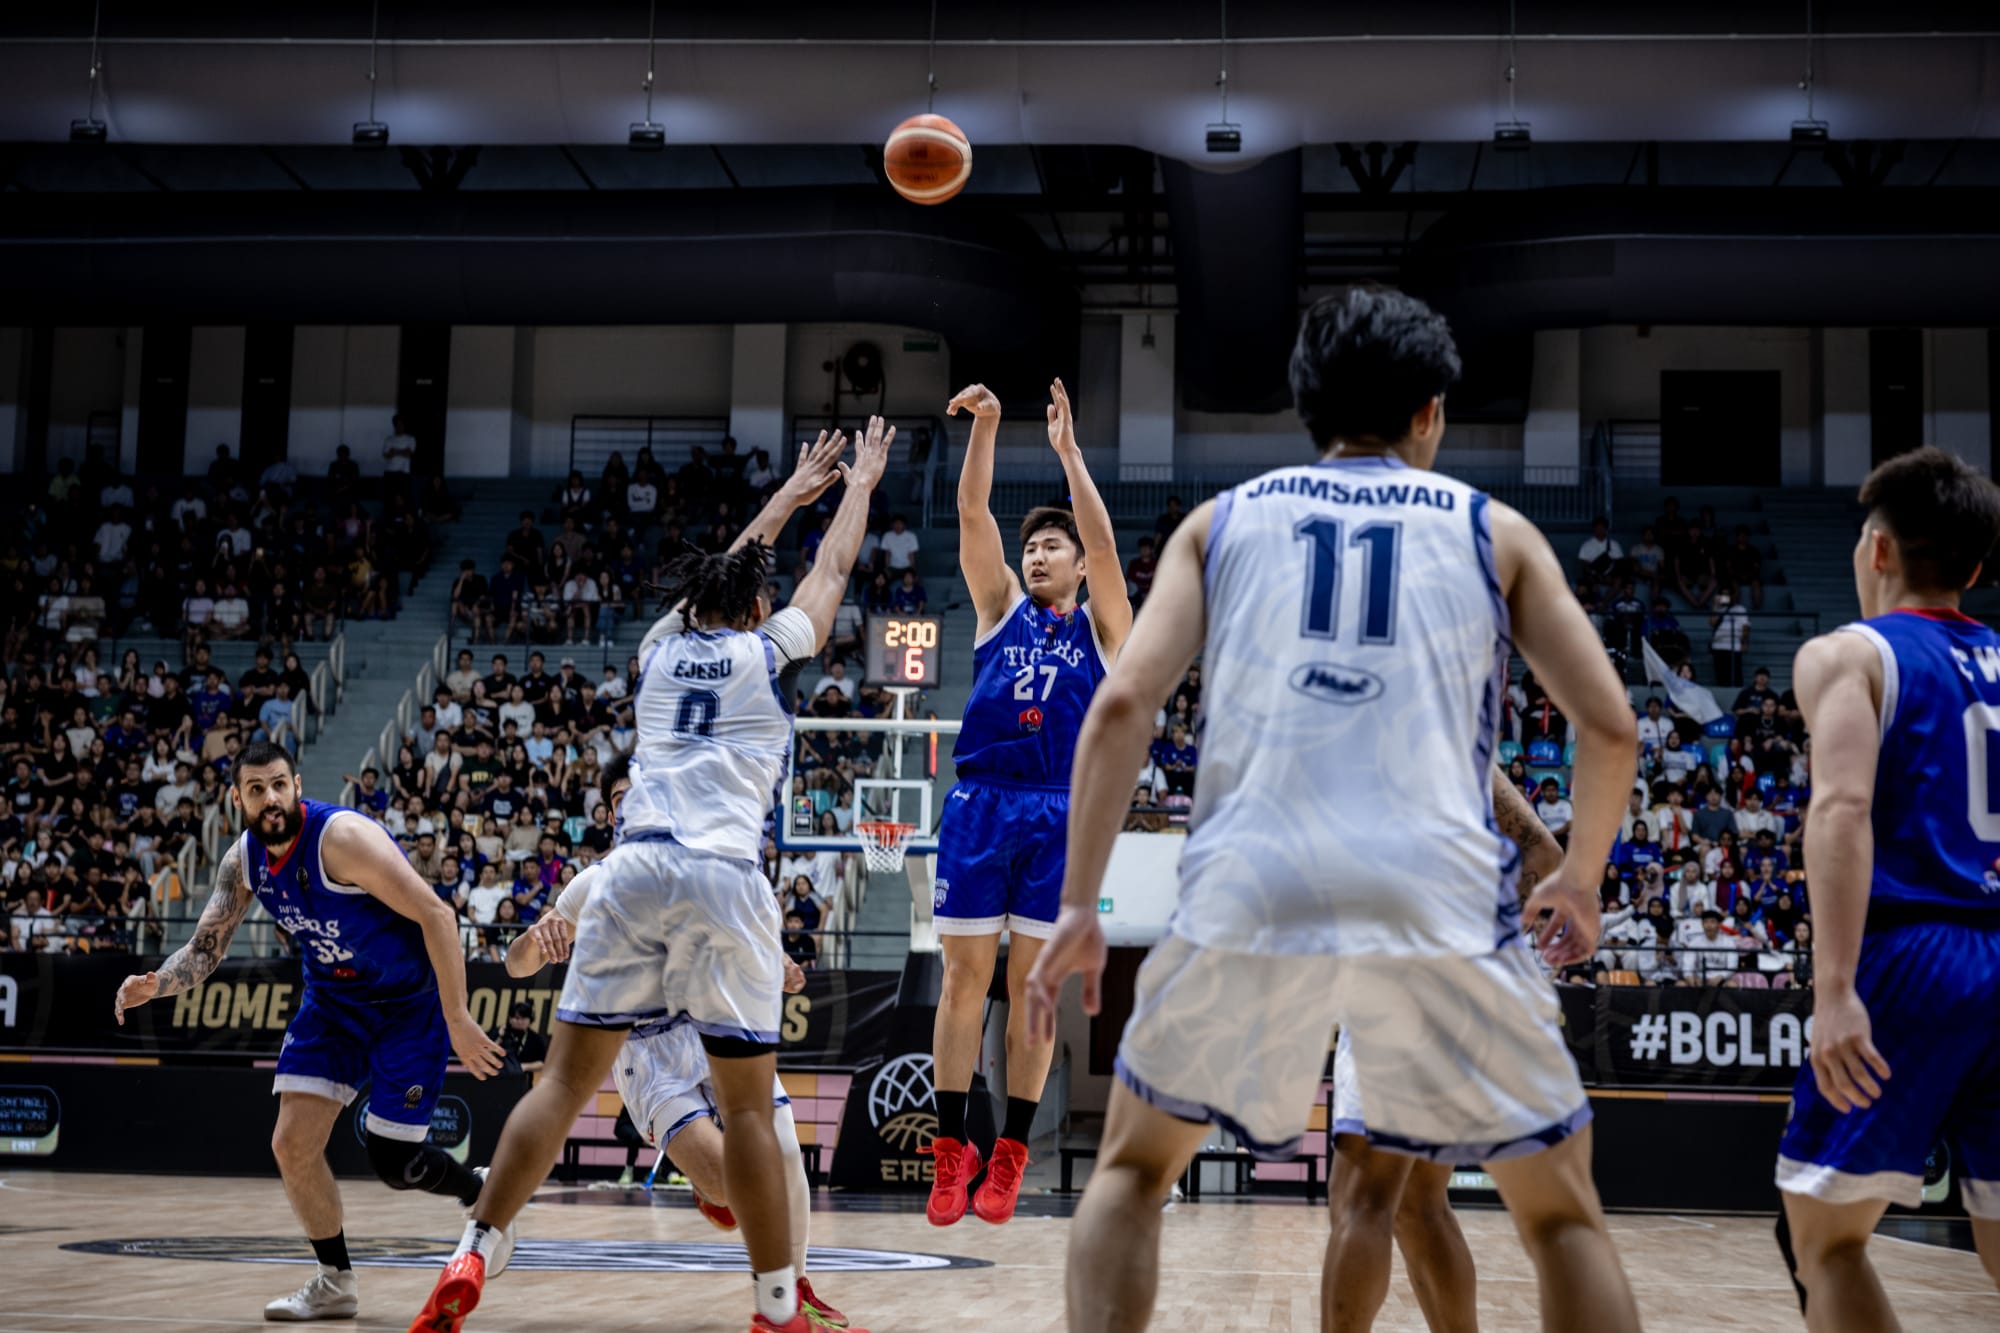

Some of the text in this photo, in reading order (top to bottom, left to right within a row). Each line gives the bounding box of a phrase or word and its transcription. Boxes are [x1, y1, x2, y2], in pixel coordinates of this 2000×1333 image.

[1247, 476, 1455, 511] JAIMSAWAD
[1294, 513, 1403, 646] 11
[885, 621, 937, 648] 2:00
[674, 657, 732, 680] EJESU
[905, 647, 925, 681] 6
[1003, 640, 1085, 668] TIGRS
[1014, 664, 1058, 702] 27
[674, 688, 721, 738] 0
[309, 939, 353, 965] 32
[172, 982, 293, 1030] HOME
[880, 1159, 936, 1182] EAS
